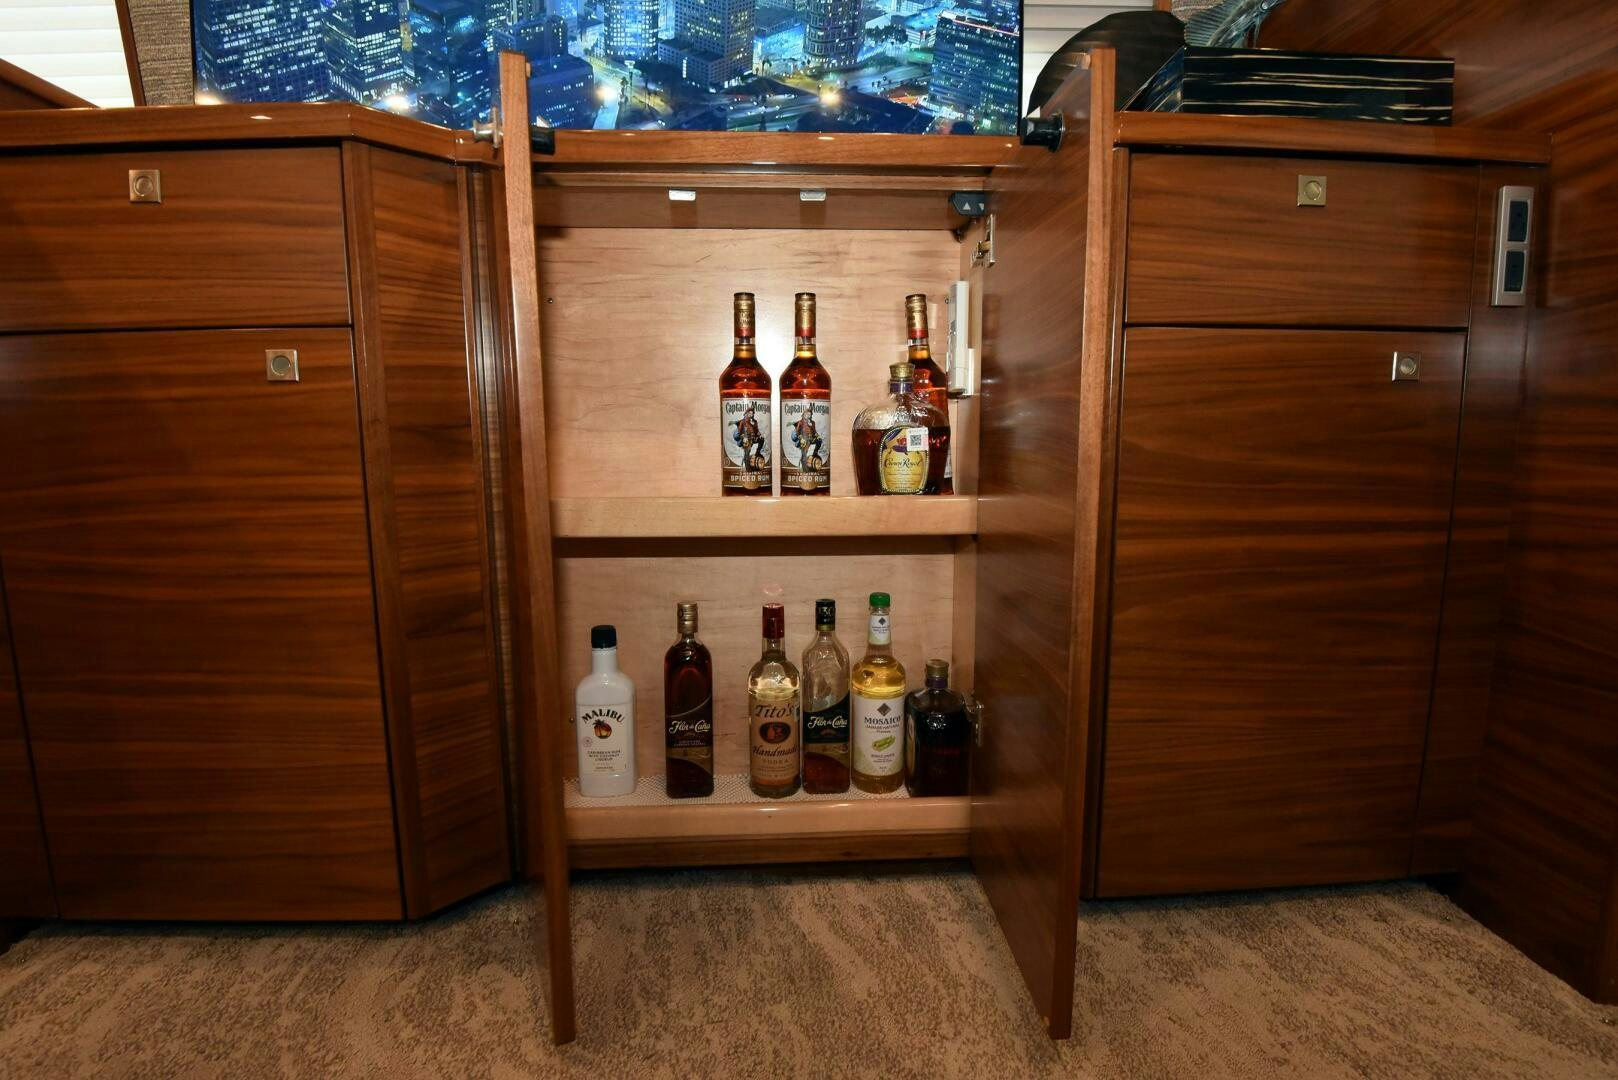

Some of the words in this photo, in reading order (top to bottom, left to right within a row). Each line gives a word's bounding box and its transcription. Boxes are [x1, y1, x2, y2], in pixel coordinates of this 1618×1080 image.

[581, 709, 625, 724] MALIBU
[755, 703, 794, 718] Tito's
[669, 720, 688, 734] Flor
[808, 716, 826, 728] Flor
